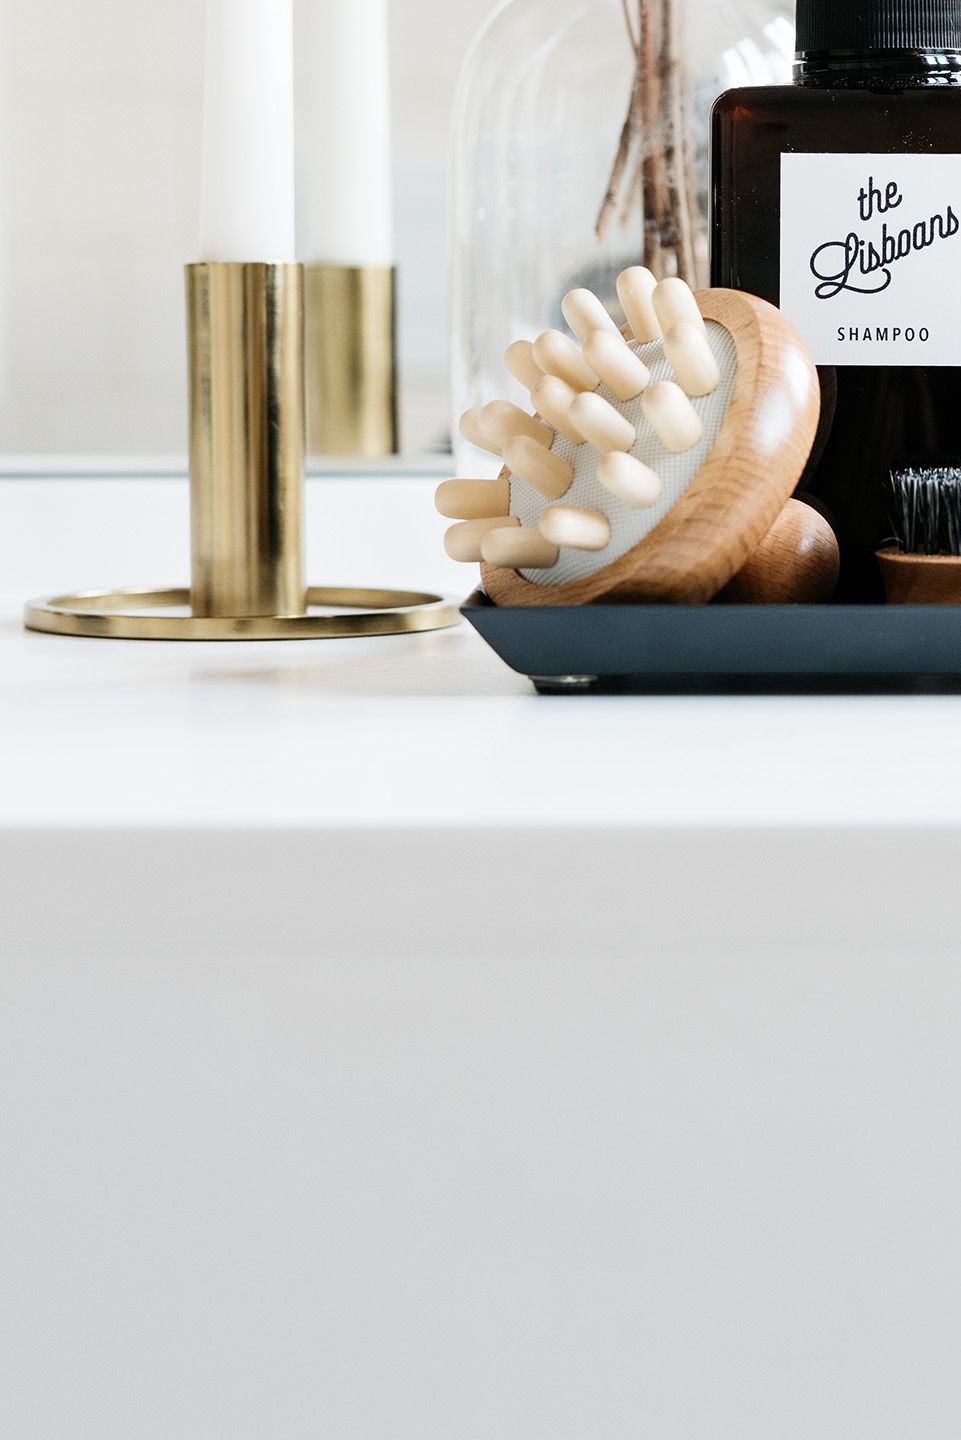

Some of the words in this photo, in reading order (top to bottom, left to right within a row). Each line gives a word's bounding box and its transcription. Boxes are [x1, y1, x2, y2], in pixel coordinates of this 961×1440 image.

[857, 176, 903, 221] the
[809, 205, 960, 300] Lisboans
[837, 326, 930, 342] SHAMPOO
